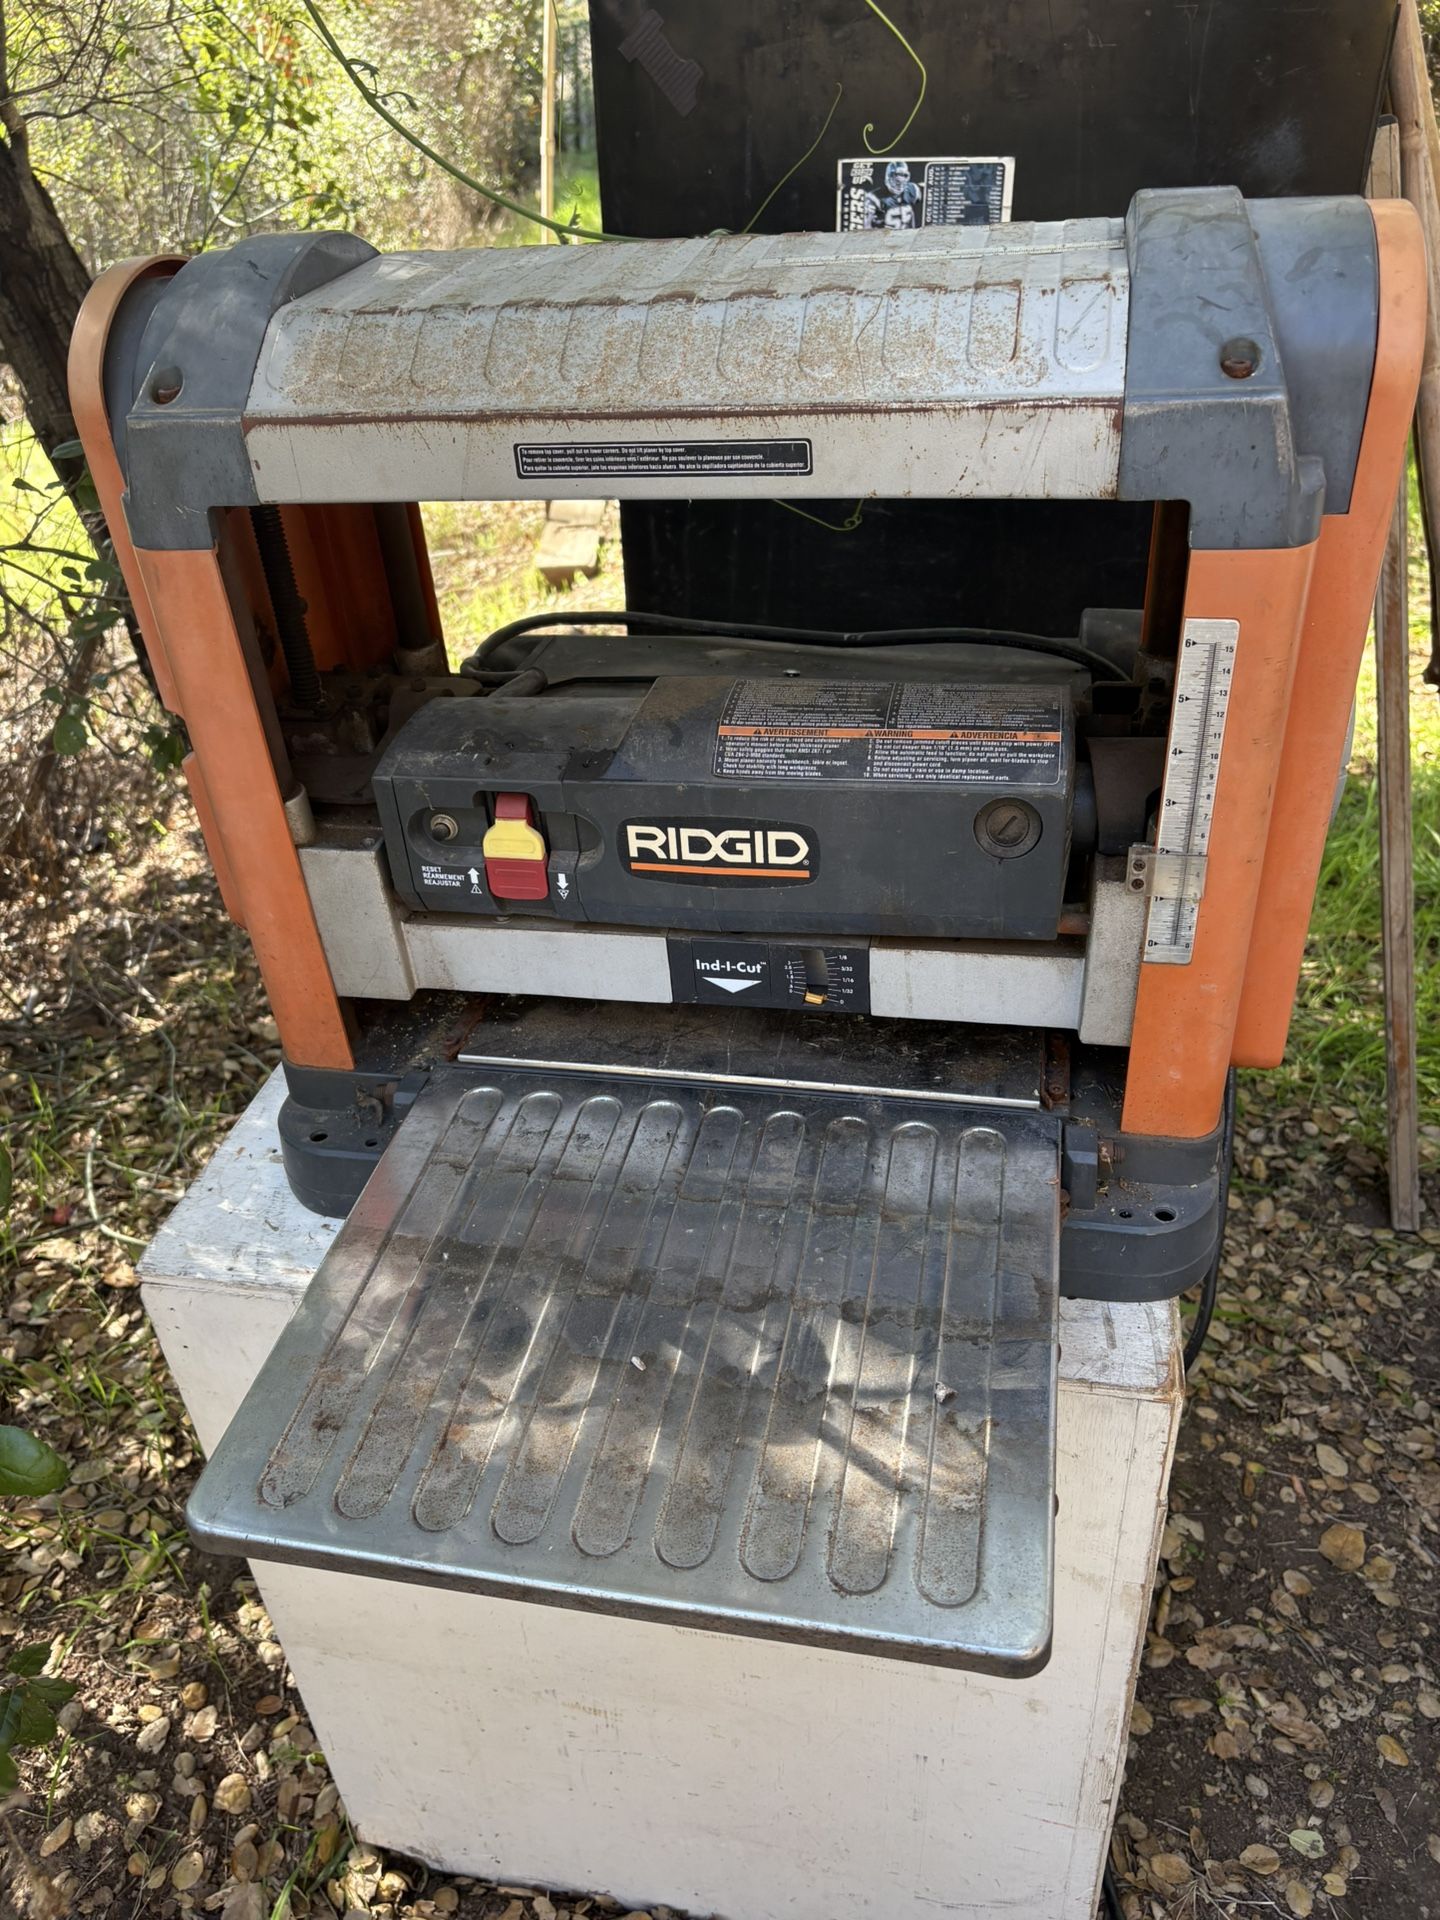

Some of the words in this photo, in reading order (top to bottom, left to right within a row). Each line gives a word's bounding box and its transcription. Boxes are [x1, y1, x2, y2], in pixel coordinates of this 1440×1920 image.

[1185, 639, 1191, 648] 6
[1179, 695, 1184, 703] 5
[1172, 748, 1177, 756] 4
